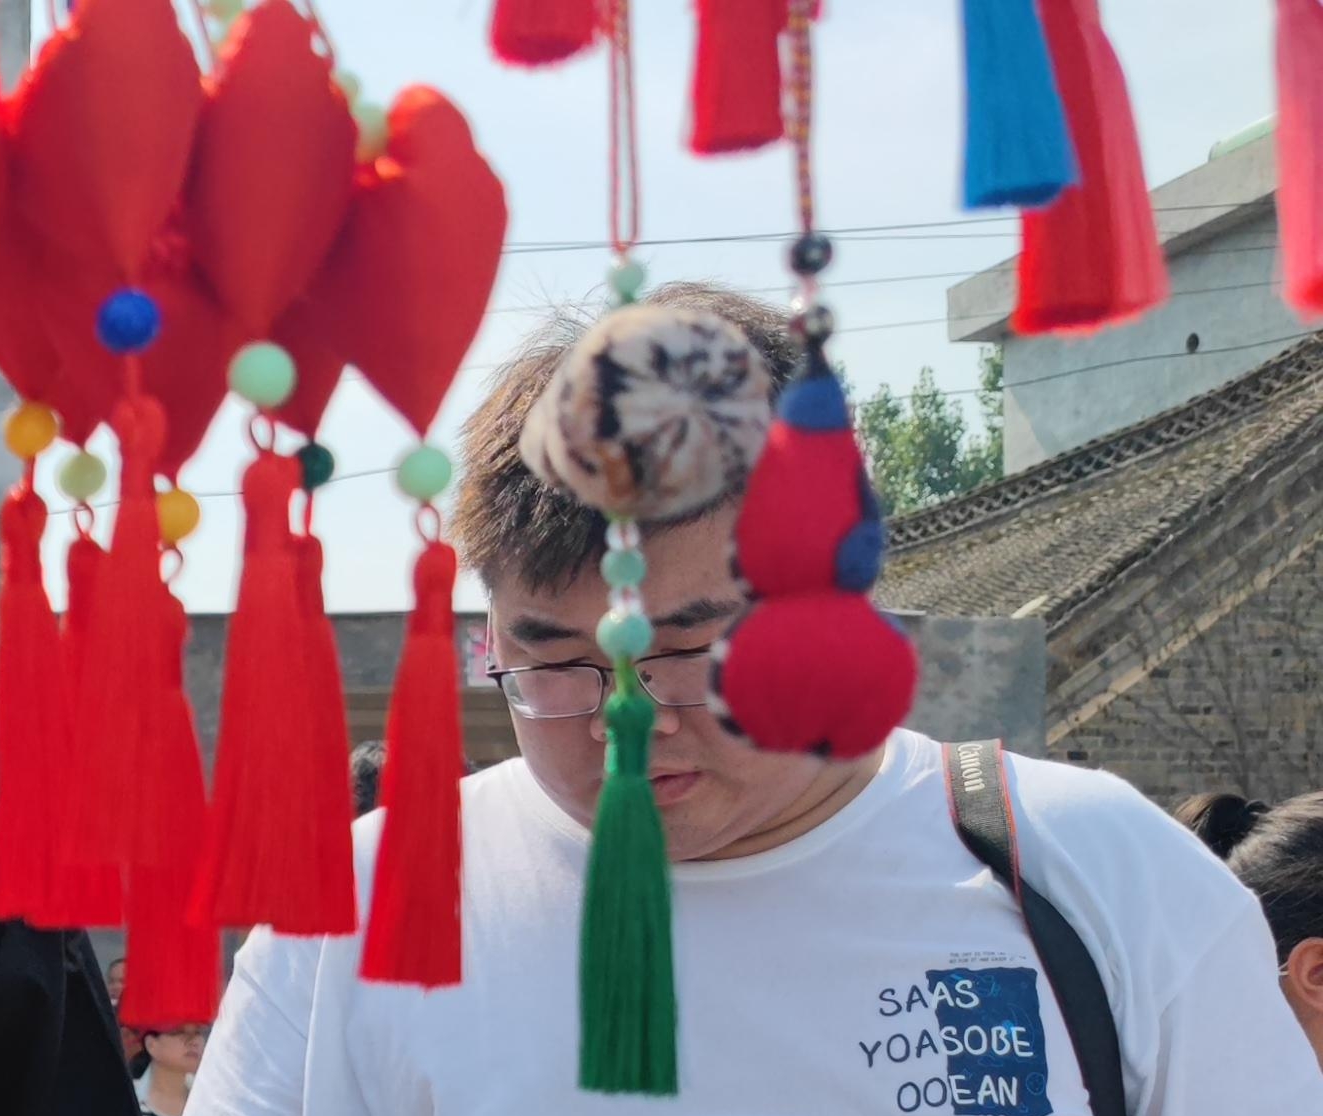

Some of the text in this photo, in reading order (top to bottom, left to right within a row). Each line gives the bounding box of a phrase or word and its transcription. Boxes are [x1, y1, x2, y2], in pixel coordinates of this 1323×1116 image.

[957, 743, 985, 792] Canon
[878, 979, 980, 1017] SAAS
[858, 1025, 1034, 1069] YOASOBE
[896, 1074, 1018, 1113] OOEAN
